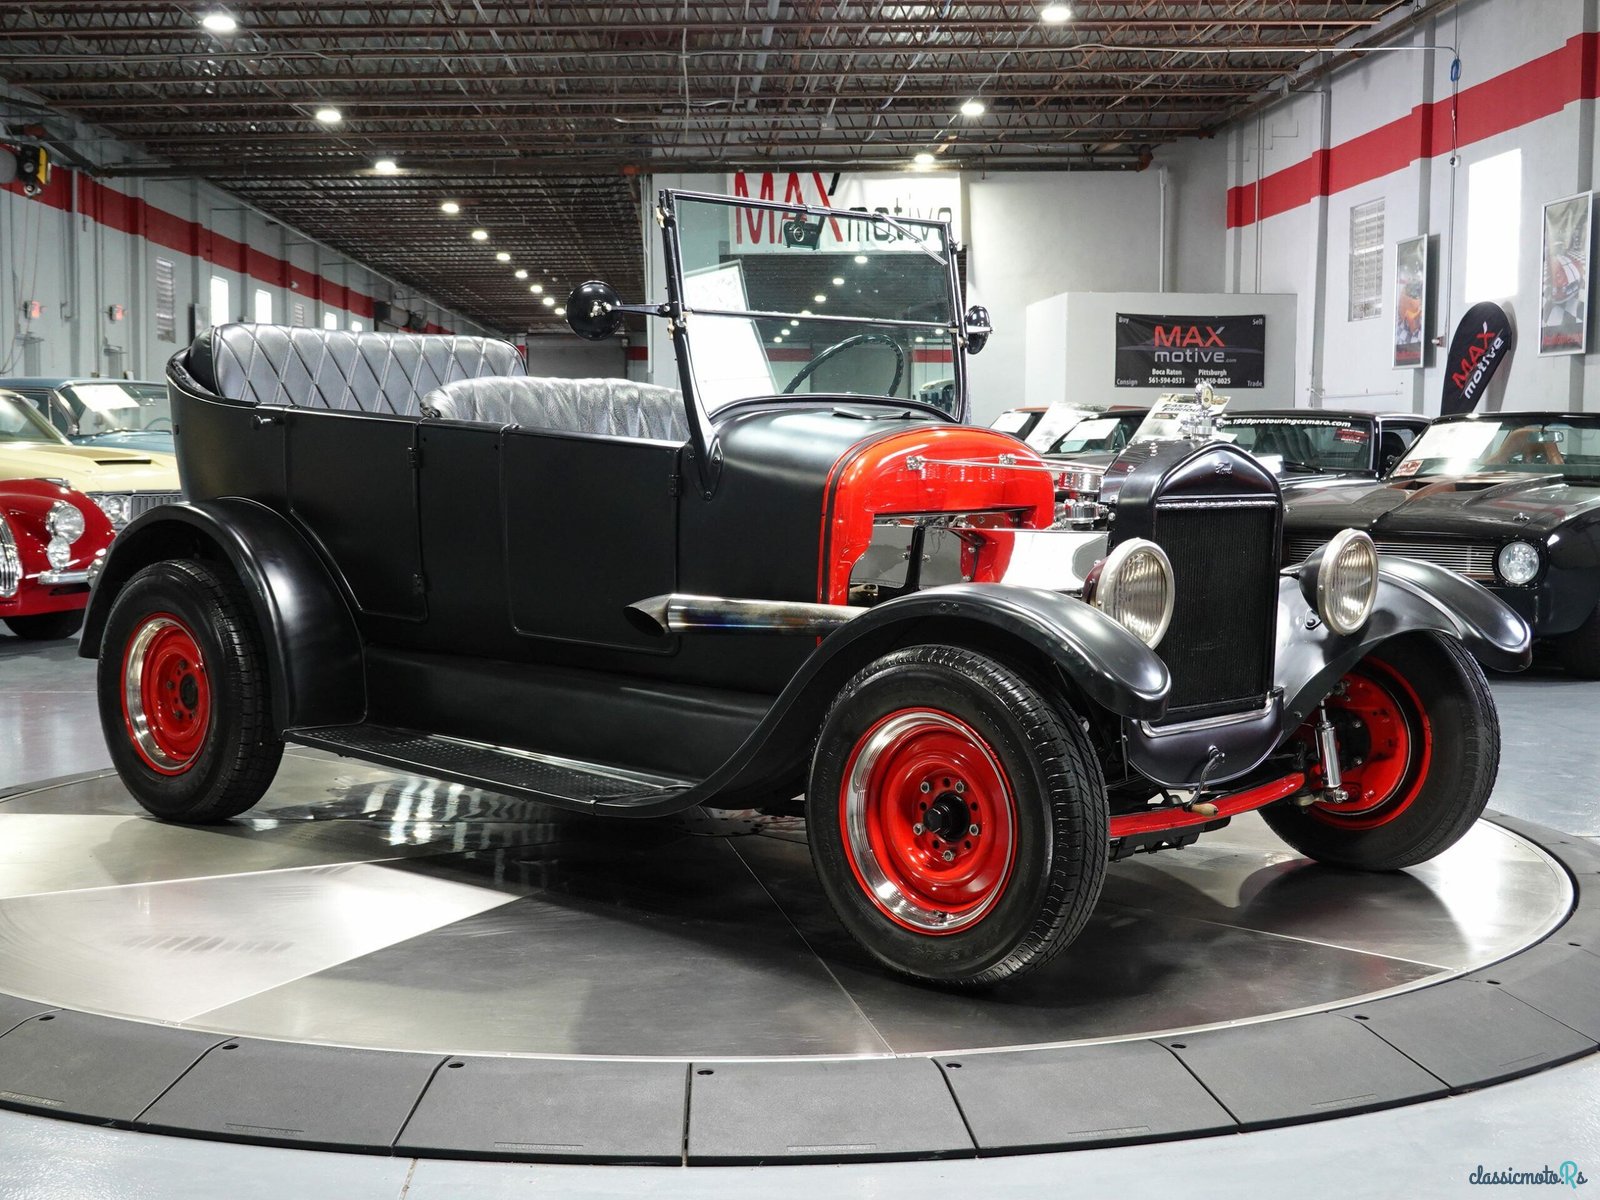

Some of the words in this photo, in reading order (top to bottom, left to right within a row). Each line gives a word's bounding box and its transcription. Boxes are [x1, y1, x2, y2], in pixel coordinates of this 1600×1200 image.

[1154, 325, 1225, 347] MAX
[1452, 321, 1496, 390] MAX
[1166, 368, 1182, 376] Raton
[1464, 336, 1505, 400] motive
[1198, 369, 1227, 377] Pittsburgh
[1116, 378, 1138, 387] Consign
[1223, 418, 1351, 427] w.1969protouringcamaro.com
